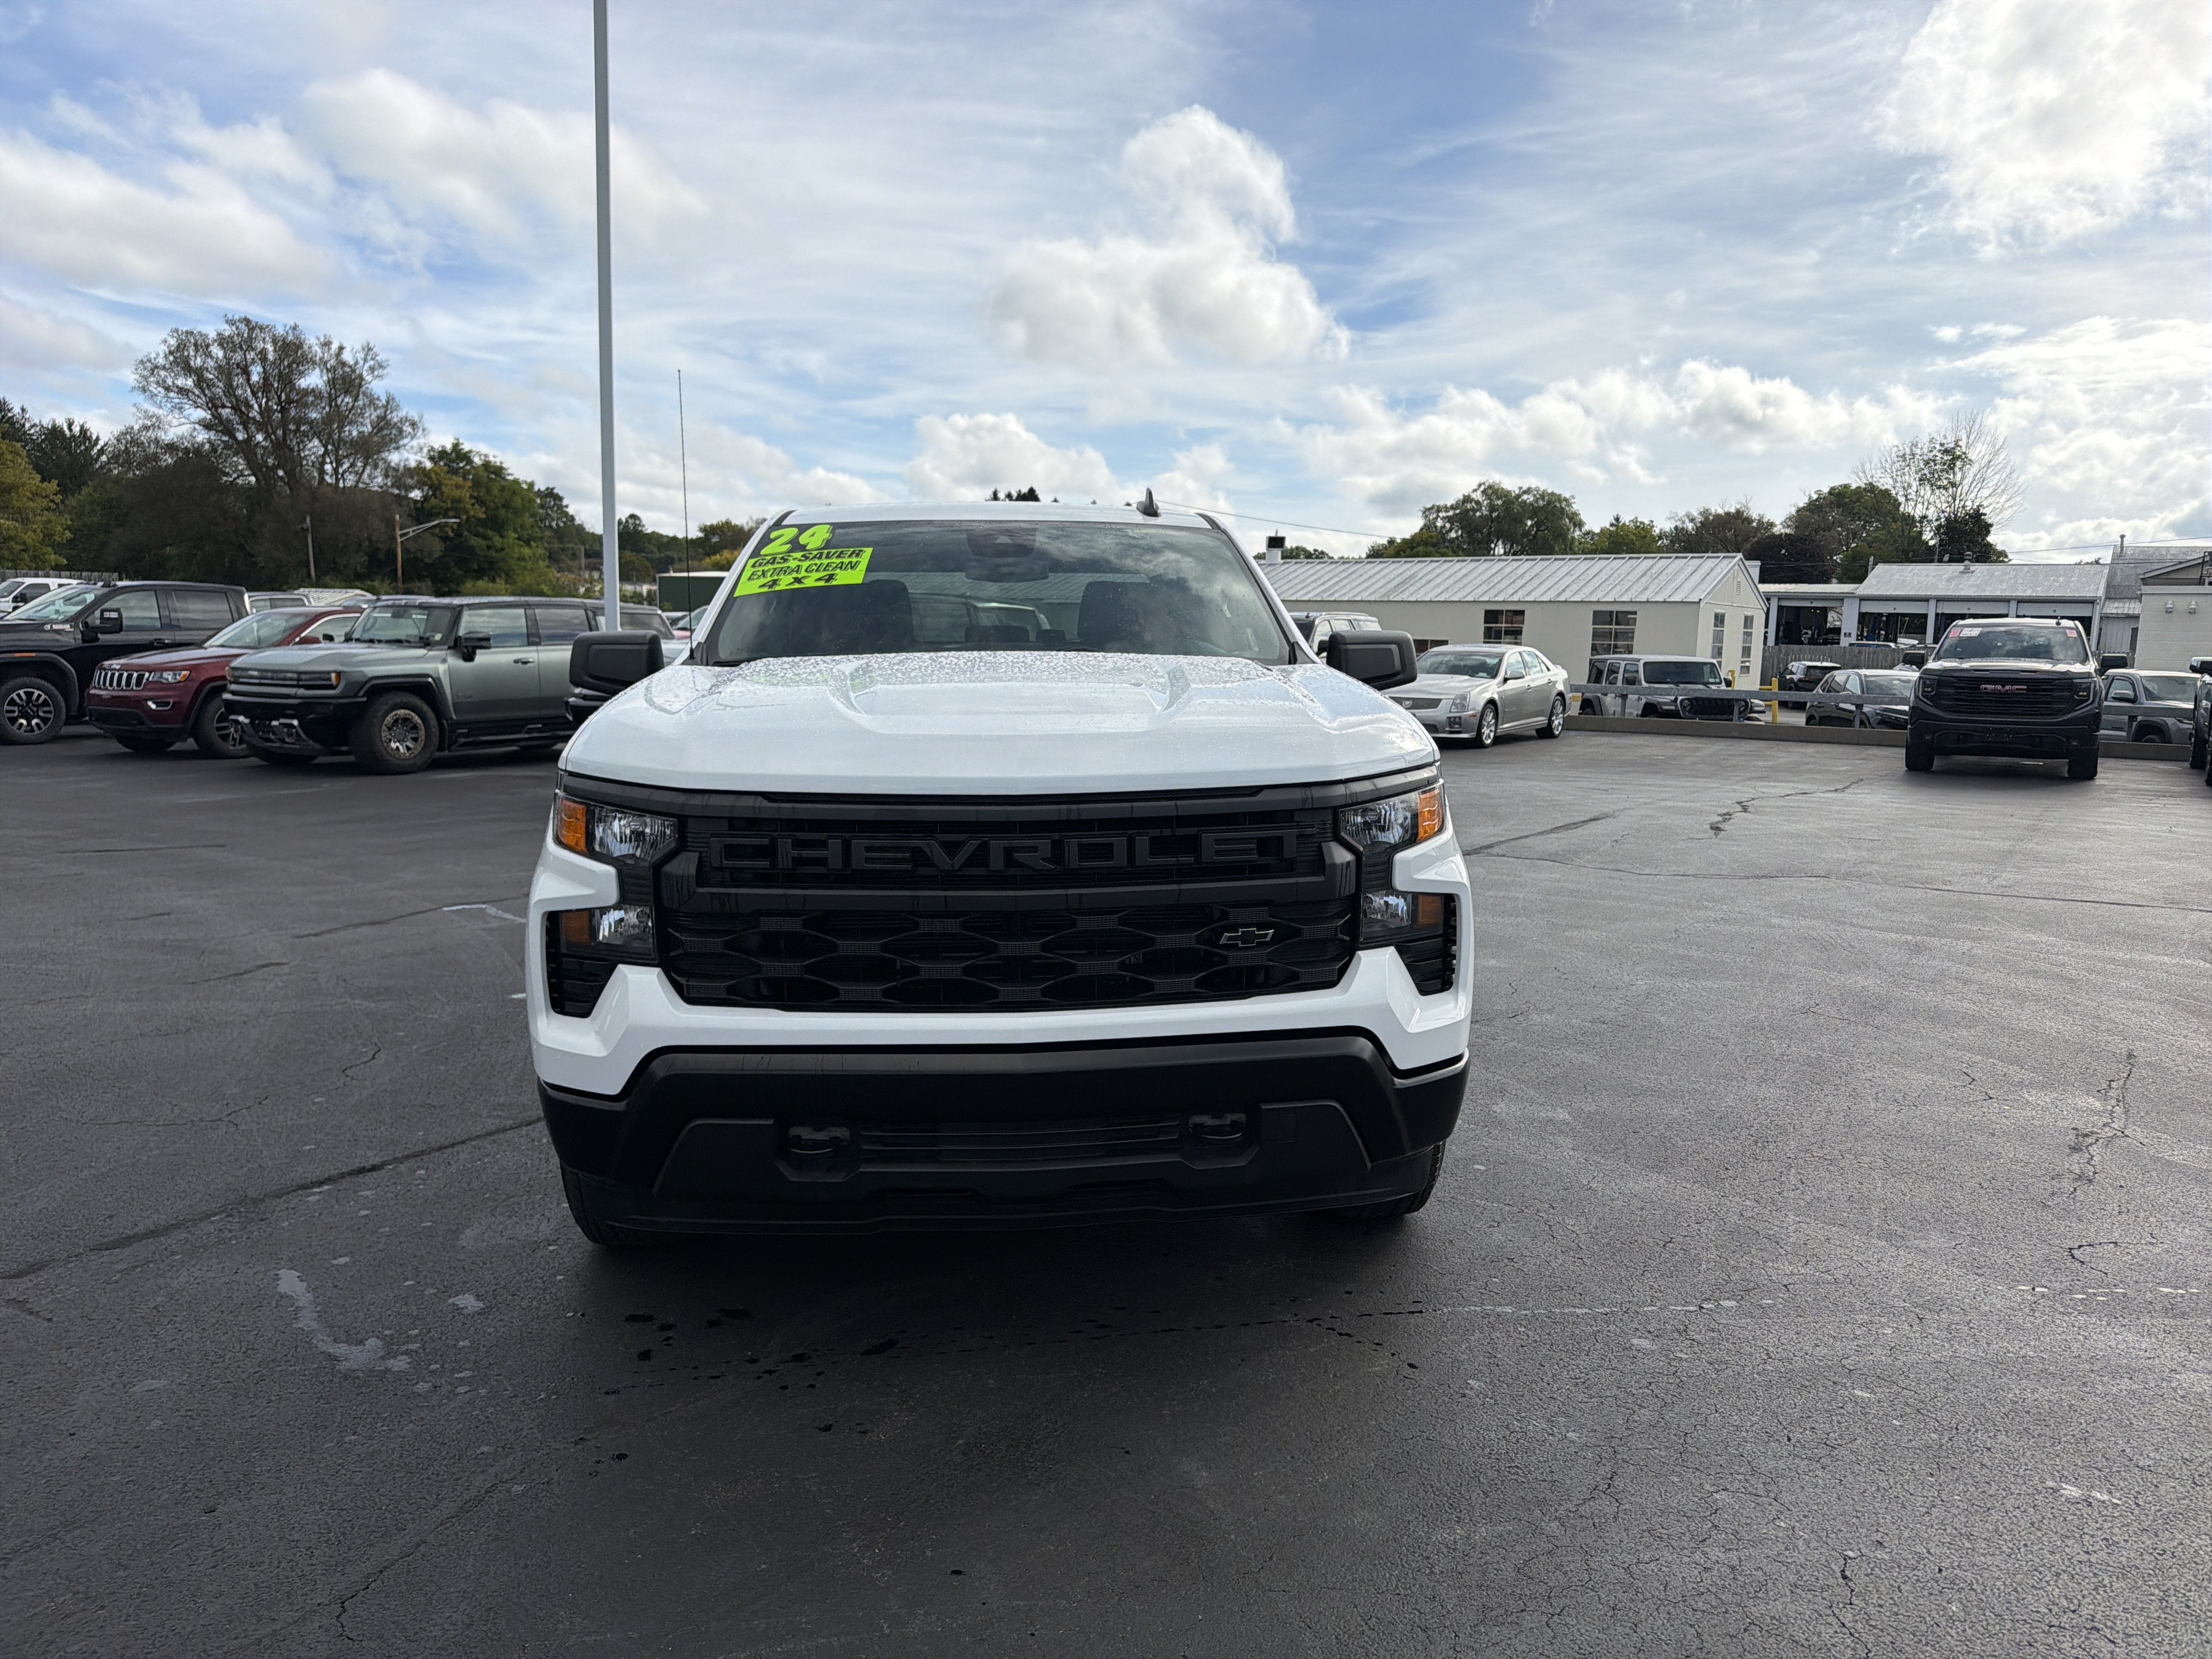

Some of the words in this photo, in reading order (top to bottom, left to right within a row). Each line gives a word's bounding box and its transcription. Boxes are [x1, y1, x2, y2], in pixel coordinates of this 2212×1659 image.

[760, 524, 833, 555] 24
[751, 549, 866, 568] GAS-SAVER
[747, 565, 803, 582] EXTRA
[804, 561, 862, 574] CLEAN
[1980, 684, 2028, 693] GMC
[710, 828, 1317, 871] CHEVROLET
